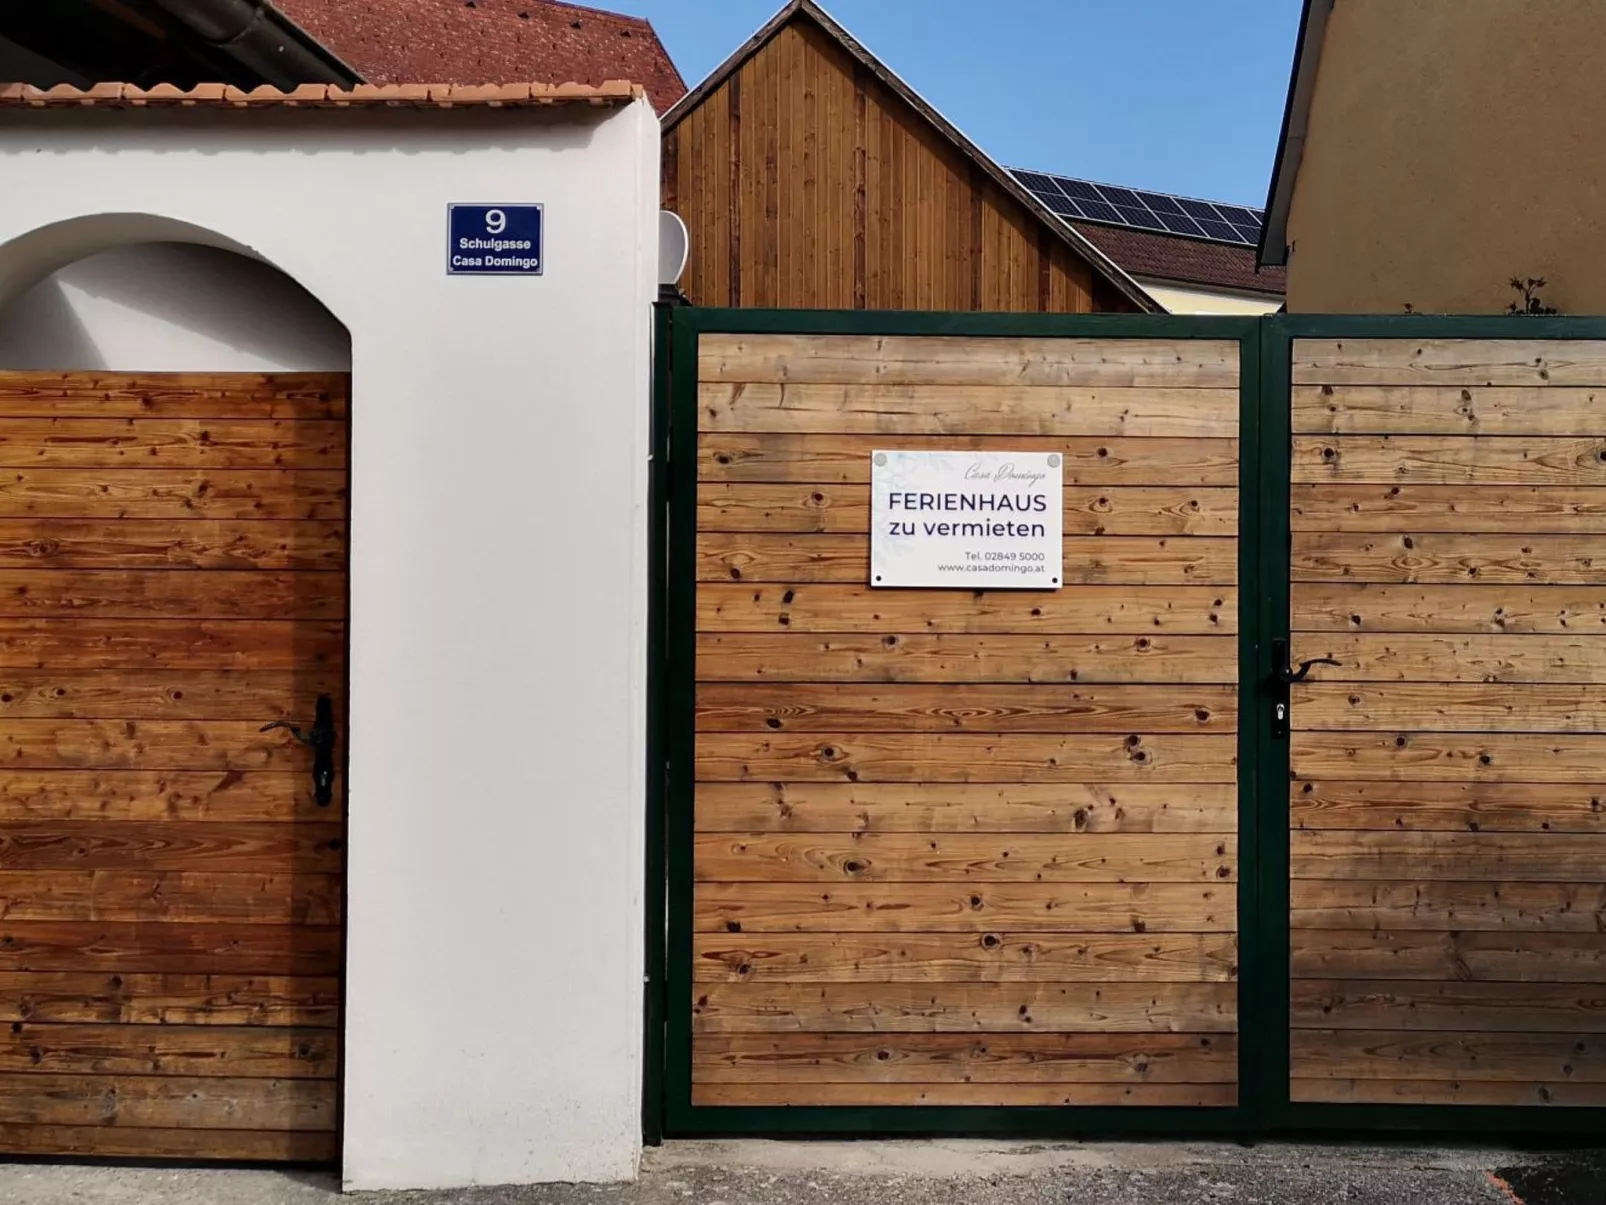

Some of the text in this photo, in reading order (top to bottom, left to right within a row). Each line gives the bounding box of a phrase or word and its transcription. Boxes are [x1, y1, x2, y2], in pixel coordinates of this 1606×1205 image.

[485, 209, 507, 234] 9
[459, 237, 531, 252] Schulgasse
[452, 255, 538, 269] Casa Domingo
[964, 462, 1046, 487] Casa Domingo
[888, 492, 1047, 512] FERIENHAUS
[888, 518, 1045, 537] zu vermieten
[965, 551, 1046, 561] Tel. 02849 5000
[937, 563, 1046, 574] www.casadomingo.at
